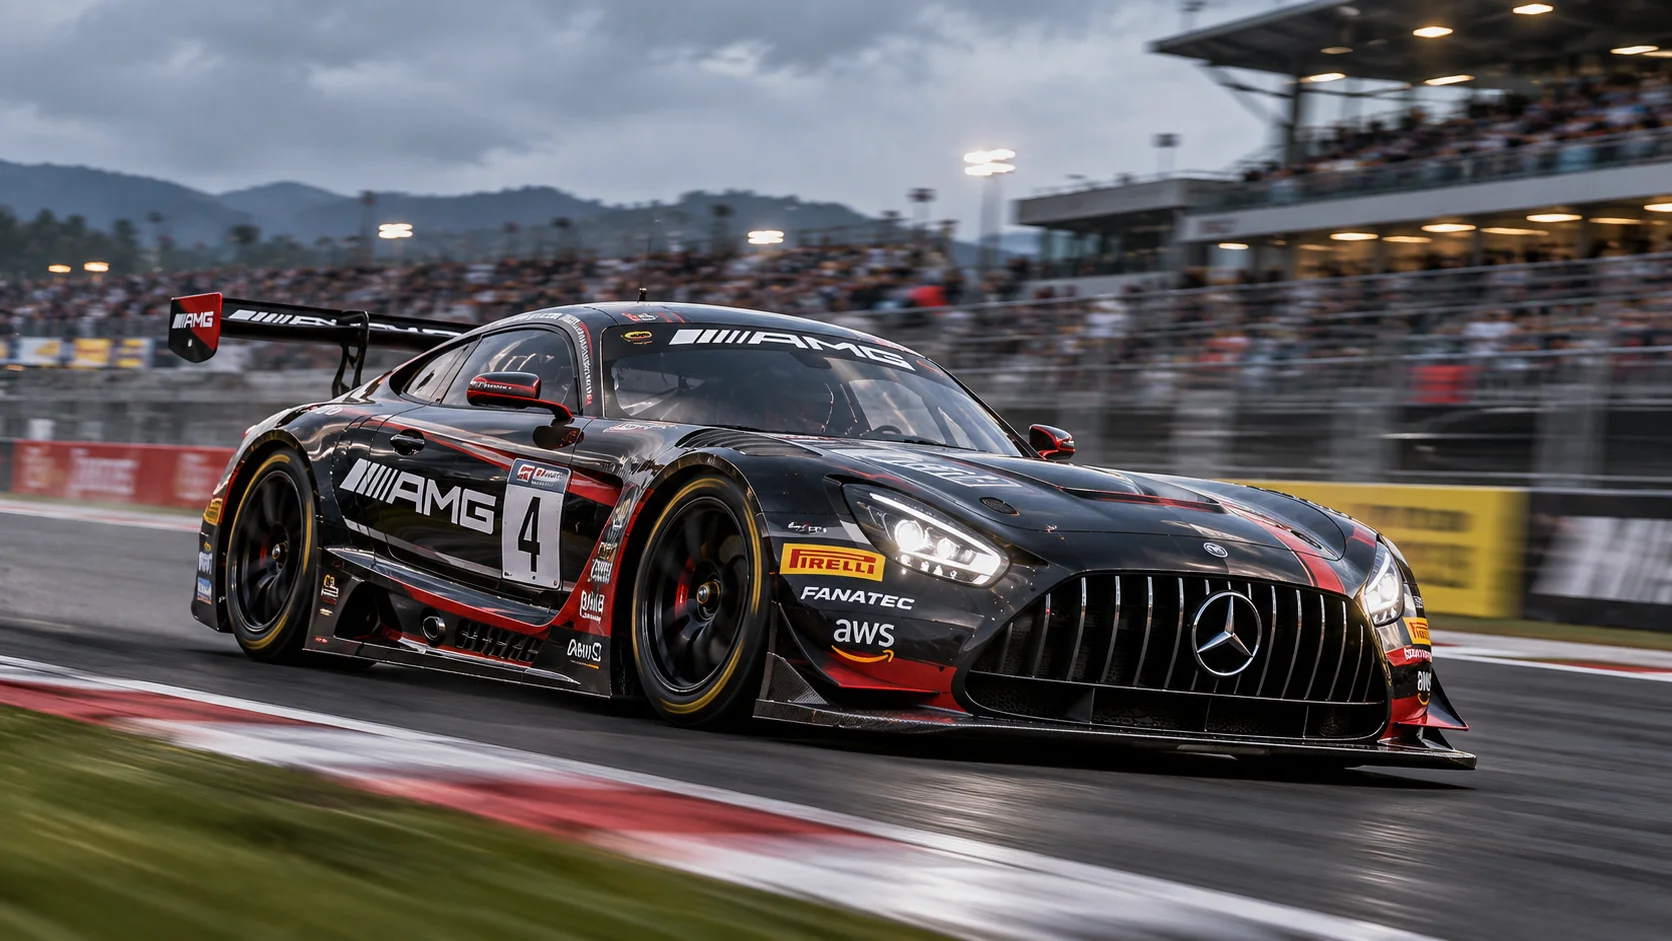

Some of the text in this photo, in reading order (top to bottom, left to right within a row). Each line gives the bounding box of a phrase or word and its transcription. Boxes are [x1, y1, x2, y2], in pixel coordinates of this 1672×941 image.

[184, 311, 214, 328] AMG
[748, 330, 916, 371] AMG
[386, 472, 496, 535] AMG
[518, 495, 542, 573] 4
[789, 549, 876, 574] PIRELLI
[800, 586, 915, 610] FANATEC
[833, 618, 895, 647] aws
